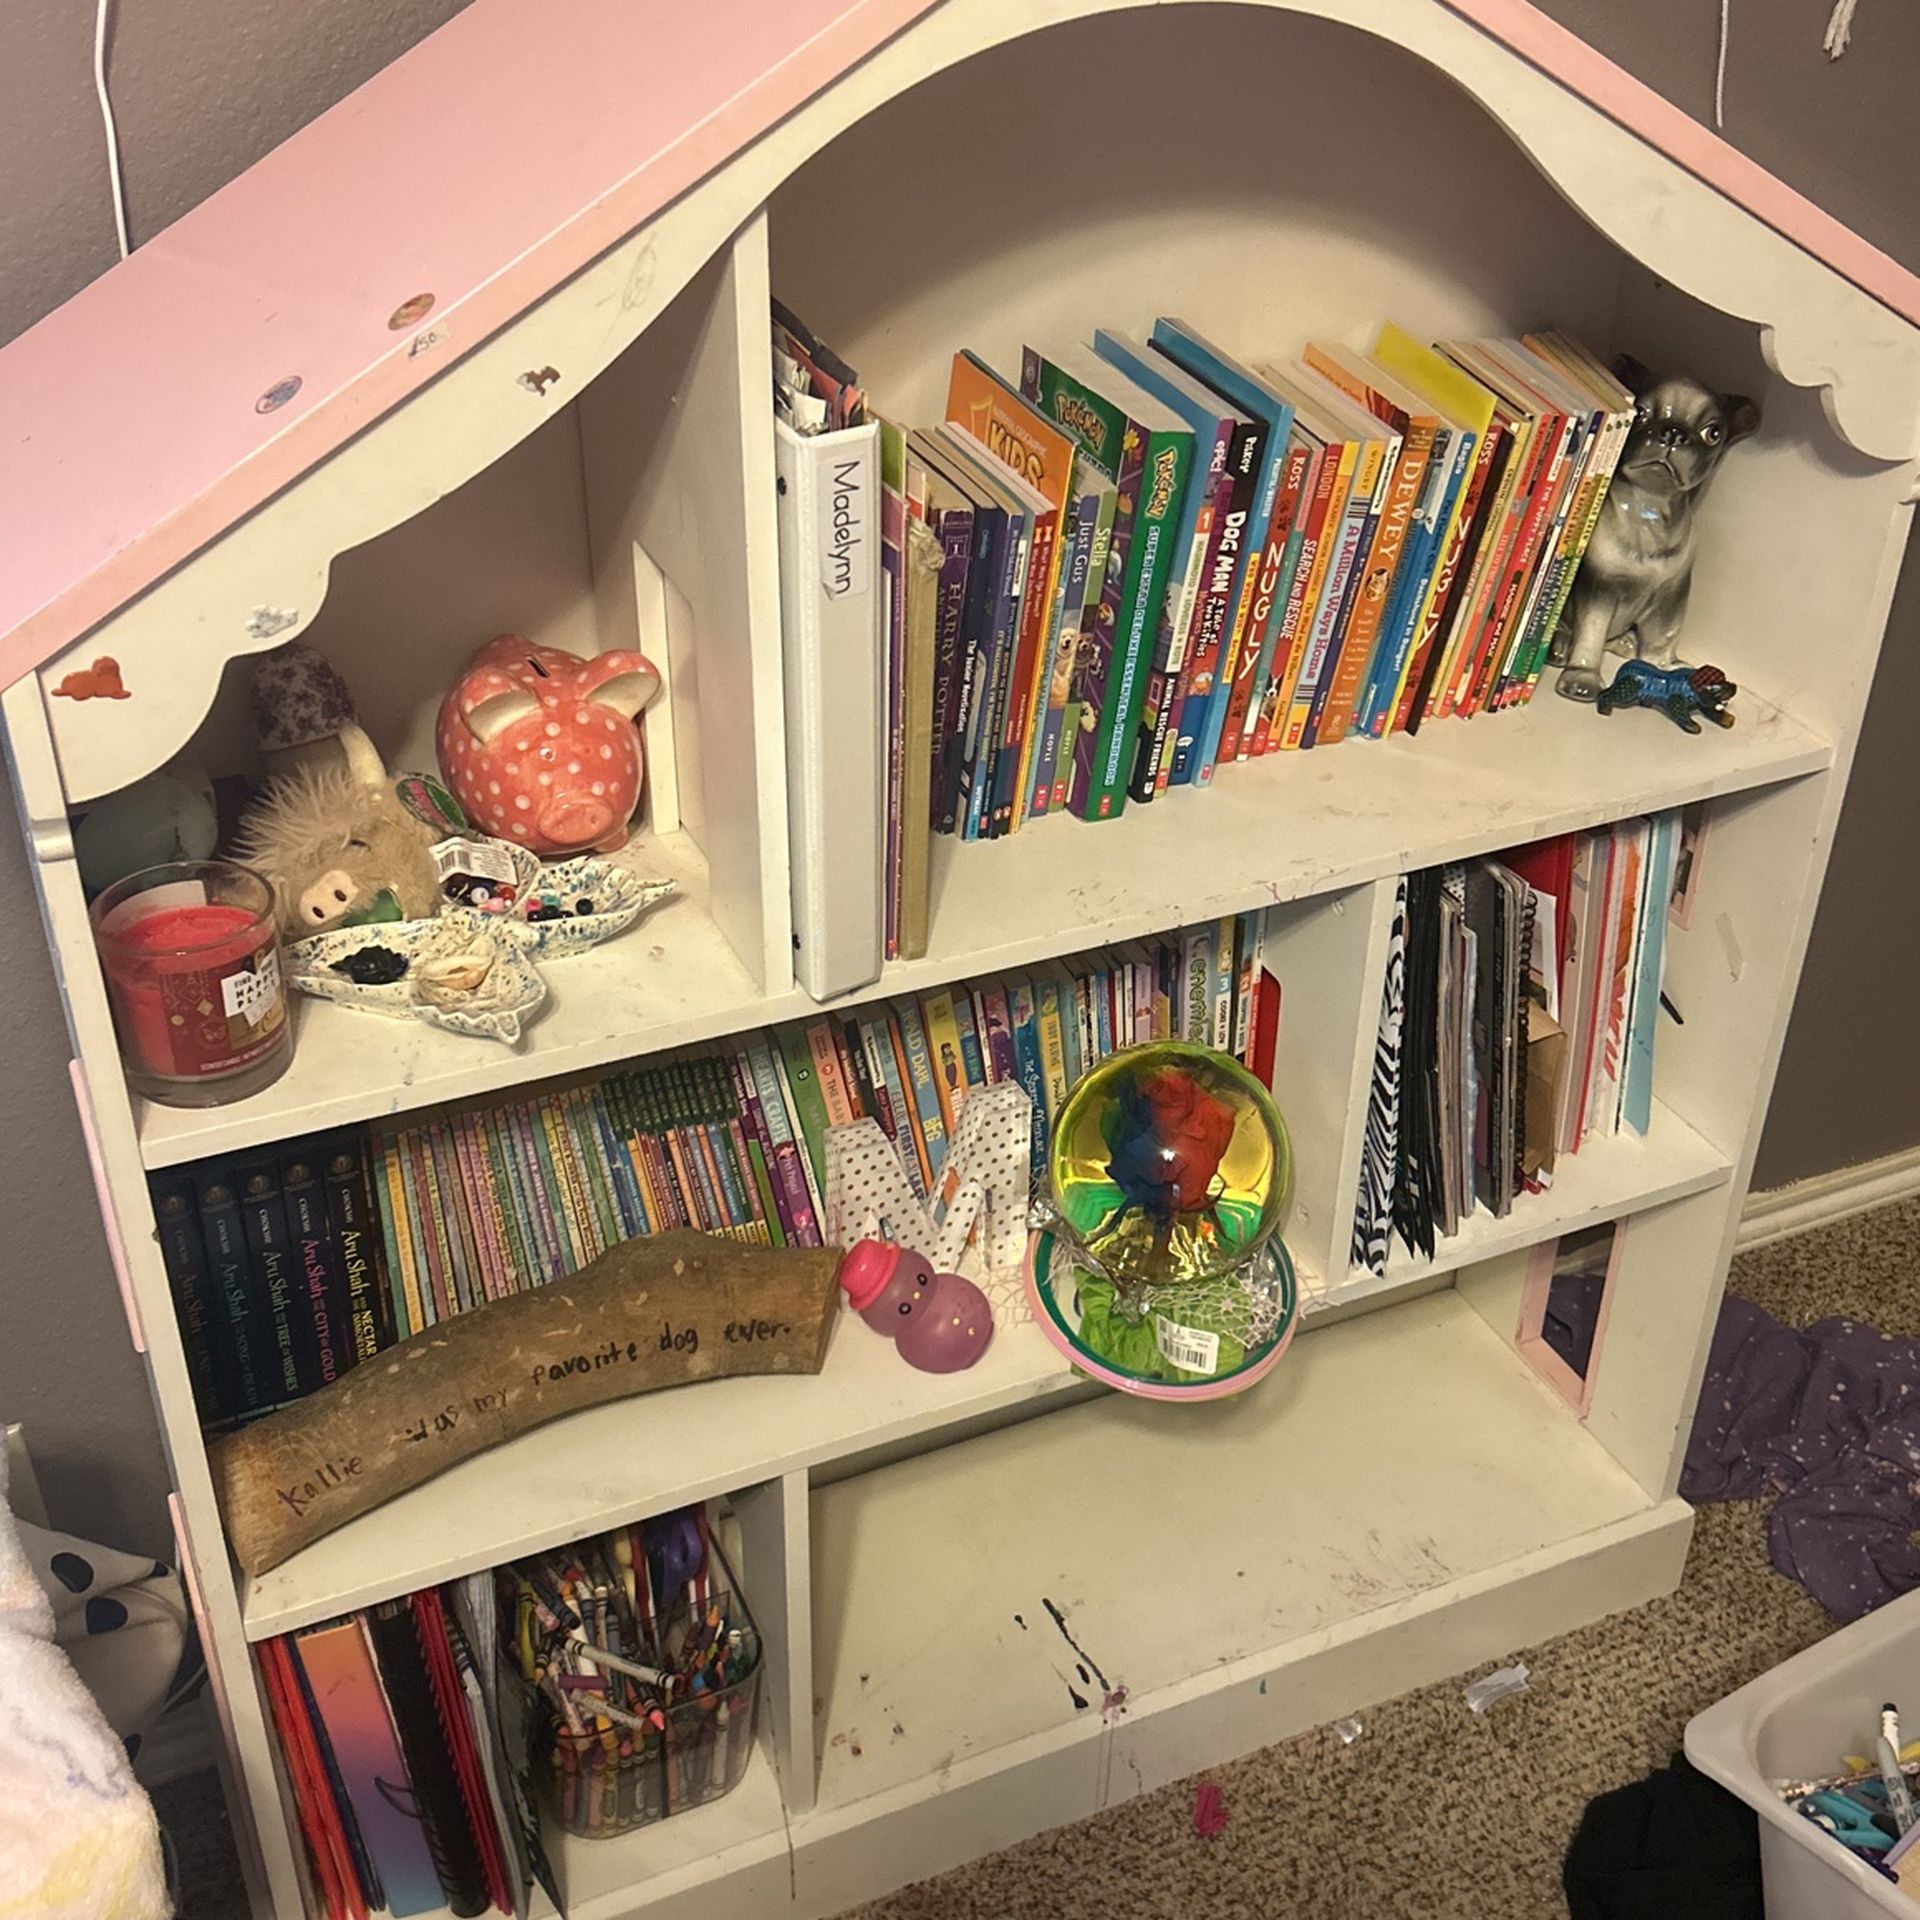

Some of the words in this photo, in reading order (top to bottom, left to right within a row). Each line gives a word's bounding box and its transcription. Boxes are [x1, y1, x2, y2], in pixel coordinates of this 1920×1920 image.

[988, 418, 1045, 493] KIDS
[1209, 439, 1226, 474] epic!
[1453, 440, 1471, 475] Baglio
[1476, 429, 1498, 466] ROSS
[1286, 454, 1305, 491] ROSS
[1315, 452, 1339, 500] LONDON
[1360, 448, 1378, 490] WINGET
[1376, 456, 1424, 561] DEWEY
[1540, 484, 1553, 502] THE
[828, 461, 861, 594] Madelynn
[1074, 519, 1095, 551] Just
[1218, 507, 1247, 554] DOG
[1345, 524, 1359, 539] A
[1528, 504, 1545, 533] PUPPY
[1089, 525, 1111, 567] Stella
[1141, 525, 1160, 568] SUPER
[1294, 537, 1318, 583] SEARCH
[1518, 535, 1534, 563] PLACE
[1070, 553, 1089, 585] Gus
[1208, 554, 1236, 595] MAN
[1330, 539, 1356, 595] Million
[1133, 567, 1153, 609] EXTRA
[1290, 581, 1302, 598] AND
[1406, 577, 1428, 626] Dachshund
[939, 582, 962, 666] HARRY
[1234, 538, 1288, 682] NUGLY
[1279, 597, 1302, 641] RESCUE
[1298, 615, 1309, 634] Wind
[1304, 601, 1313, 614] The
[1315, 592, 1340, 636] Ways
[966, 638, 976, 654] The
[1125, 609, 1145, 658] DELUXE
[1293, 642, 1302, 654] the
[962, 656, 974, 681] Junior
[1285, 654, 1299, 681] Willows
[1305, 636, 1328, 681] Home
[1391, 636, 1409, 672] Danger!
[954, 682, 972, 732] Novelization
[1114, 657, 1137, 723] ESSENTIAL
[1161, 677, 1175, 710] ANIMAL
[929, 675, 950, 758] POTTER
[1154, 710, 1169, 742] RESCUE
[1042, 732, 1055, 763] HOYLE
[1103, 723, 1125, 787] HANDBOOK
[1146, 742, 1161, 777] FRIENDS
[900, 1009, 923, 1051] ROALD
[1046, 1021, 1057, 1040] JUDY
[909, 1051, 932, 1089] DAHL
[1049, 1042, 1060, 1066] BLUME
[753, 1053, 776, 1096] HEARTS
[825, 1077, 838, 1098] THE
[764, 1100, 788, 1145] CRAFTS
[897, 1124, 915, 1157] FIRST
[921, 1114, 946, 1142] BFG
[299, 1236, 321, 1265] Aru
[339, 1228, 363, 1260] Aru
[220, 1261, 241, 1289] Aru
[262, 1248, 284, 1278] Aru
[304, 1263, 329, 1299] Shah
[343, 1258, 371, 1296] Shah
[224, 1288, 249, 1323] Shah
[267, 1276, 291, 1312] Shah
[275, 1323, 291, 1347] TREE
[312, 1311, 330, 1339] CITY
[358, 1309, 379, 1355] NECTAR
[280, 1355, 299, 1392] WISHES
[318, 1348, 337, 1382] GOLD
[275, 1453, 364, 1517] Kallie
[474, 1386, 509, 1417] my
[531, 1343, 638, 1387] favorite
[658, 1321, 699, 1355] dog
